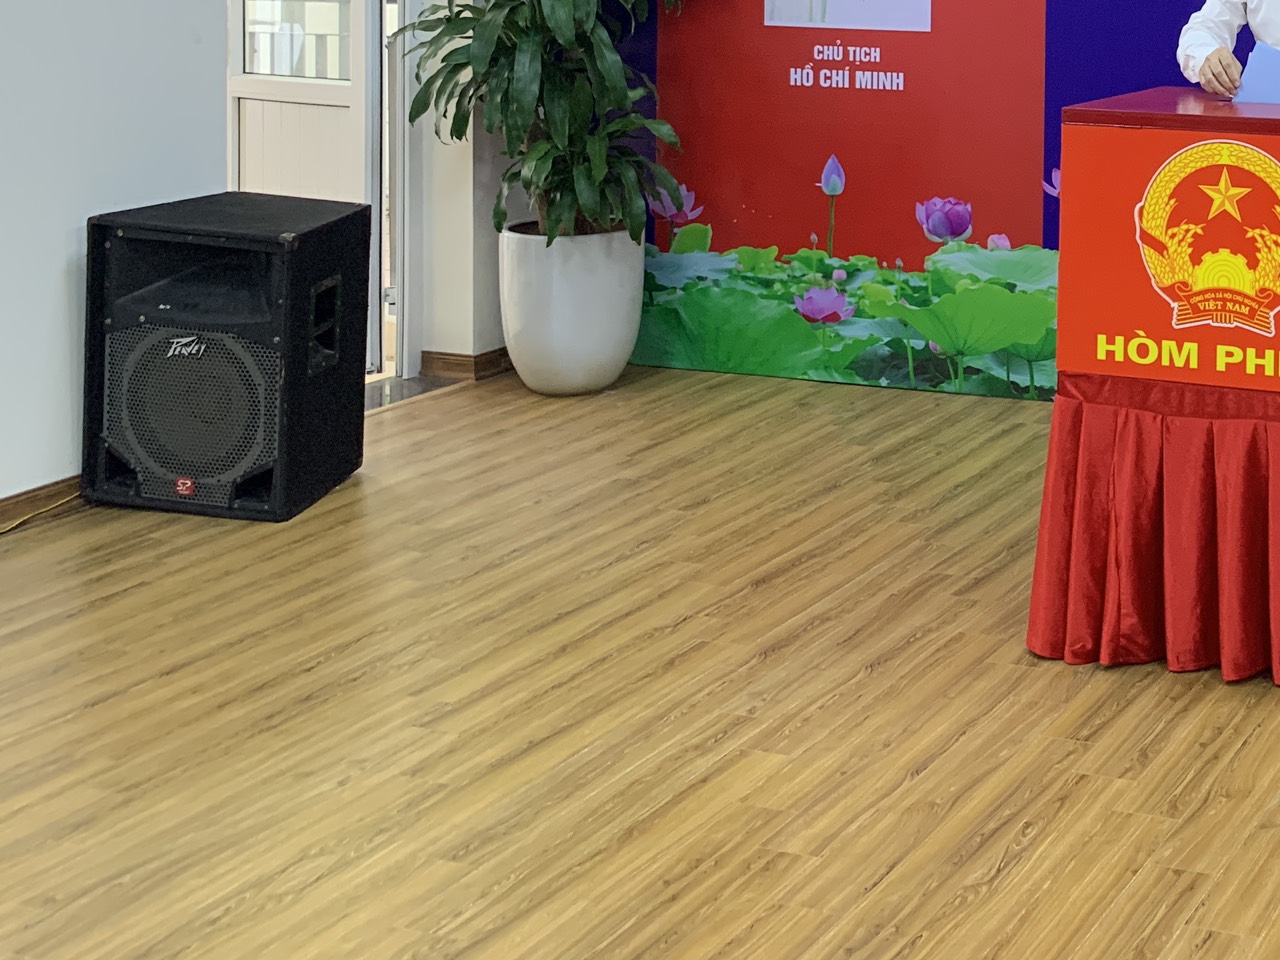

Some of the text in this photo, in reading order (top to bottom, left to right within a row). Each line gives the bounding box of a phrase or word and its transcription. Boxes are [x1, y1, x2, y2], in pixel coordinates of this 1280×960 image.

[813, 40, 881, 65] CHỦ TỊCH
[789, 62, 905, 91] HỒ CHÍ MINH
[1197, 299, 1251, 315] VIỆT NAM
[1096, 329, 1199, 370] HÒM
